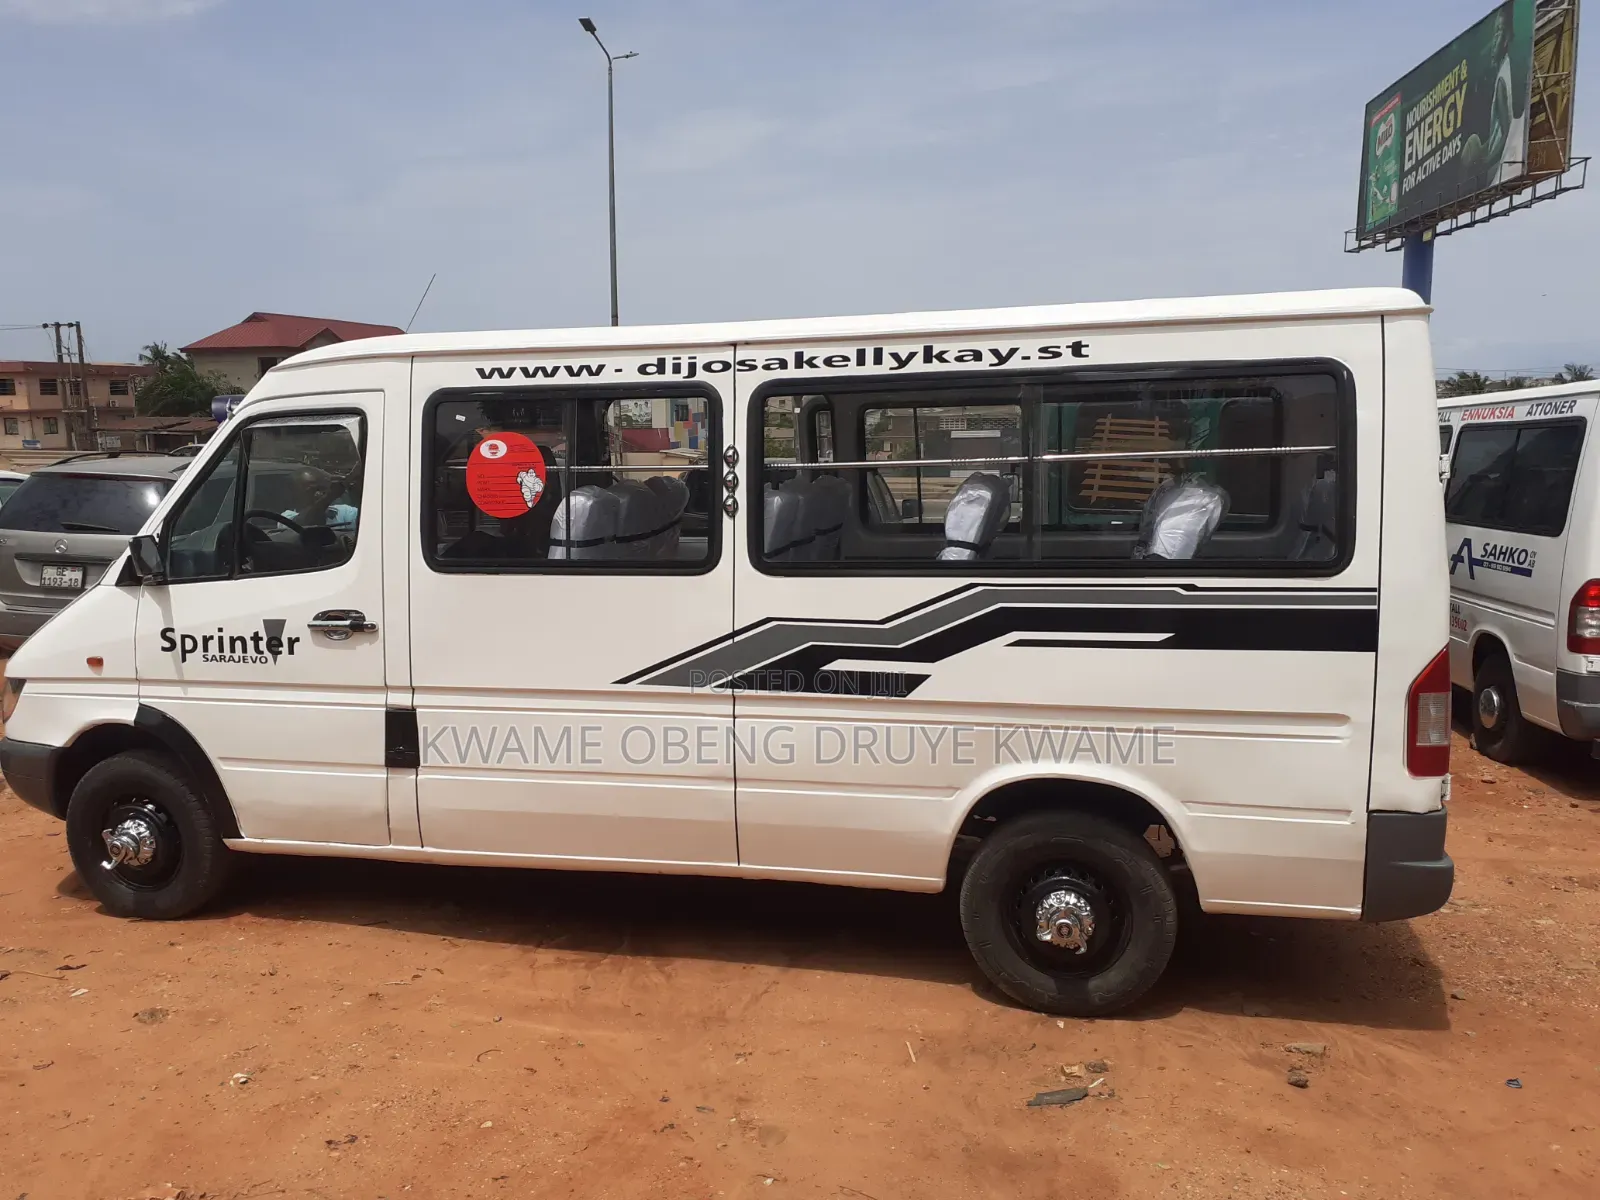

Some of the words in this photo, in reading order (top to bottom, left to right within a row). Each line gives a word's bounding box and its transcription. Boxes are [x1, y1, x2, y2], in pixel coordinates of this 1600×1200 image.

[1406, 65, 1460, 132] NOURISHMENT
[1461, 59, 1468, 81] &
[1404, 81, 1467, 172] ENERGY
[1402, 170, 1416, 195] FOR
[1416, 149, 1441, 185] ACTIVE
[1442, 133, 1462, 165] DAYS
[1460, 406, 1515, 421] ENNUKSIA
[1525, 400, 1577, 417] ATIONER
[1481, 543, 1528, 565] SAHKO
[42, 576, 79, 587] 1193-18
[56, 566, 68, 577] GE
[160, 627, 300, 663] Sprinter
[202, 653, 268, 664] SARAJEVO
